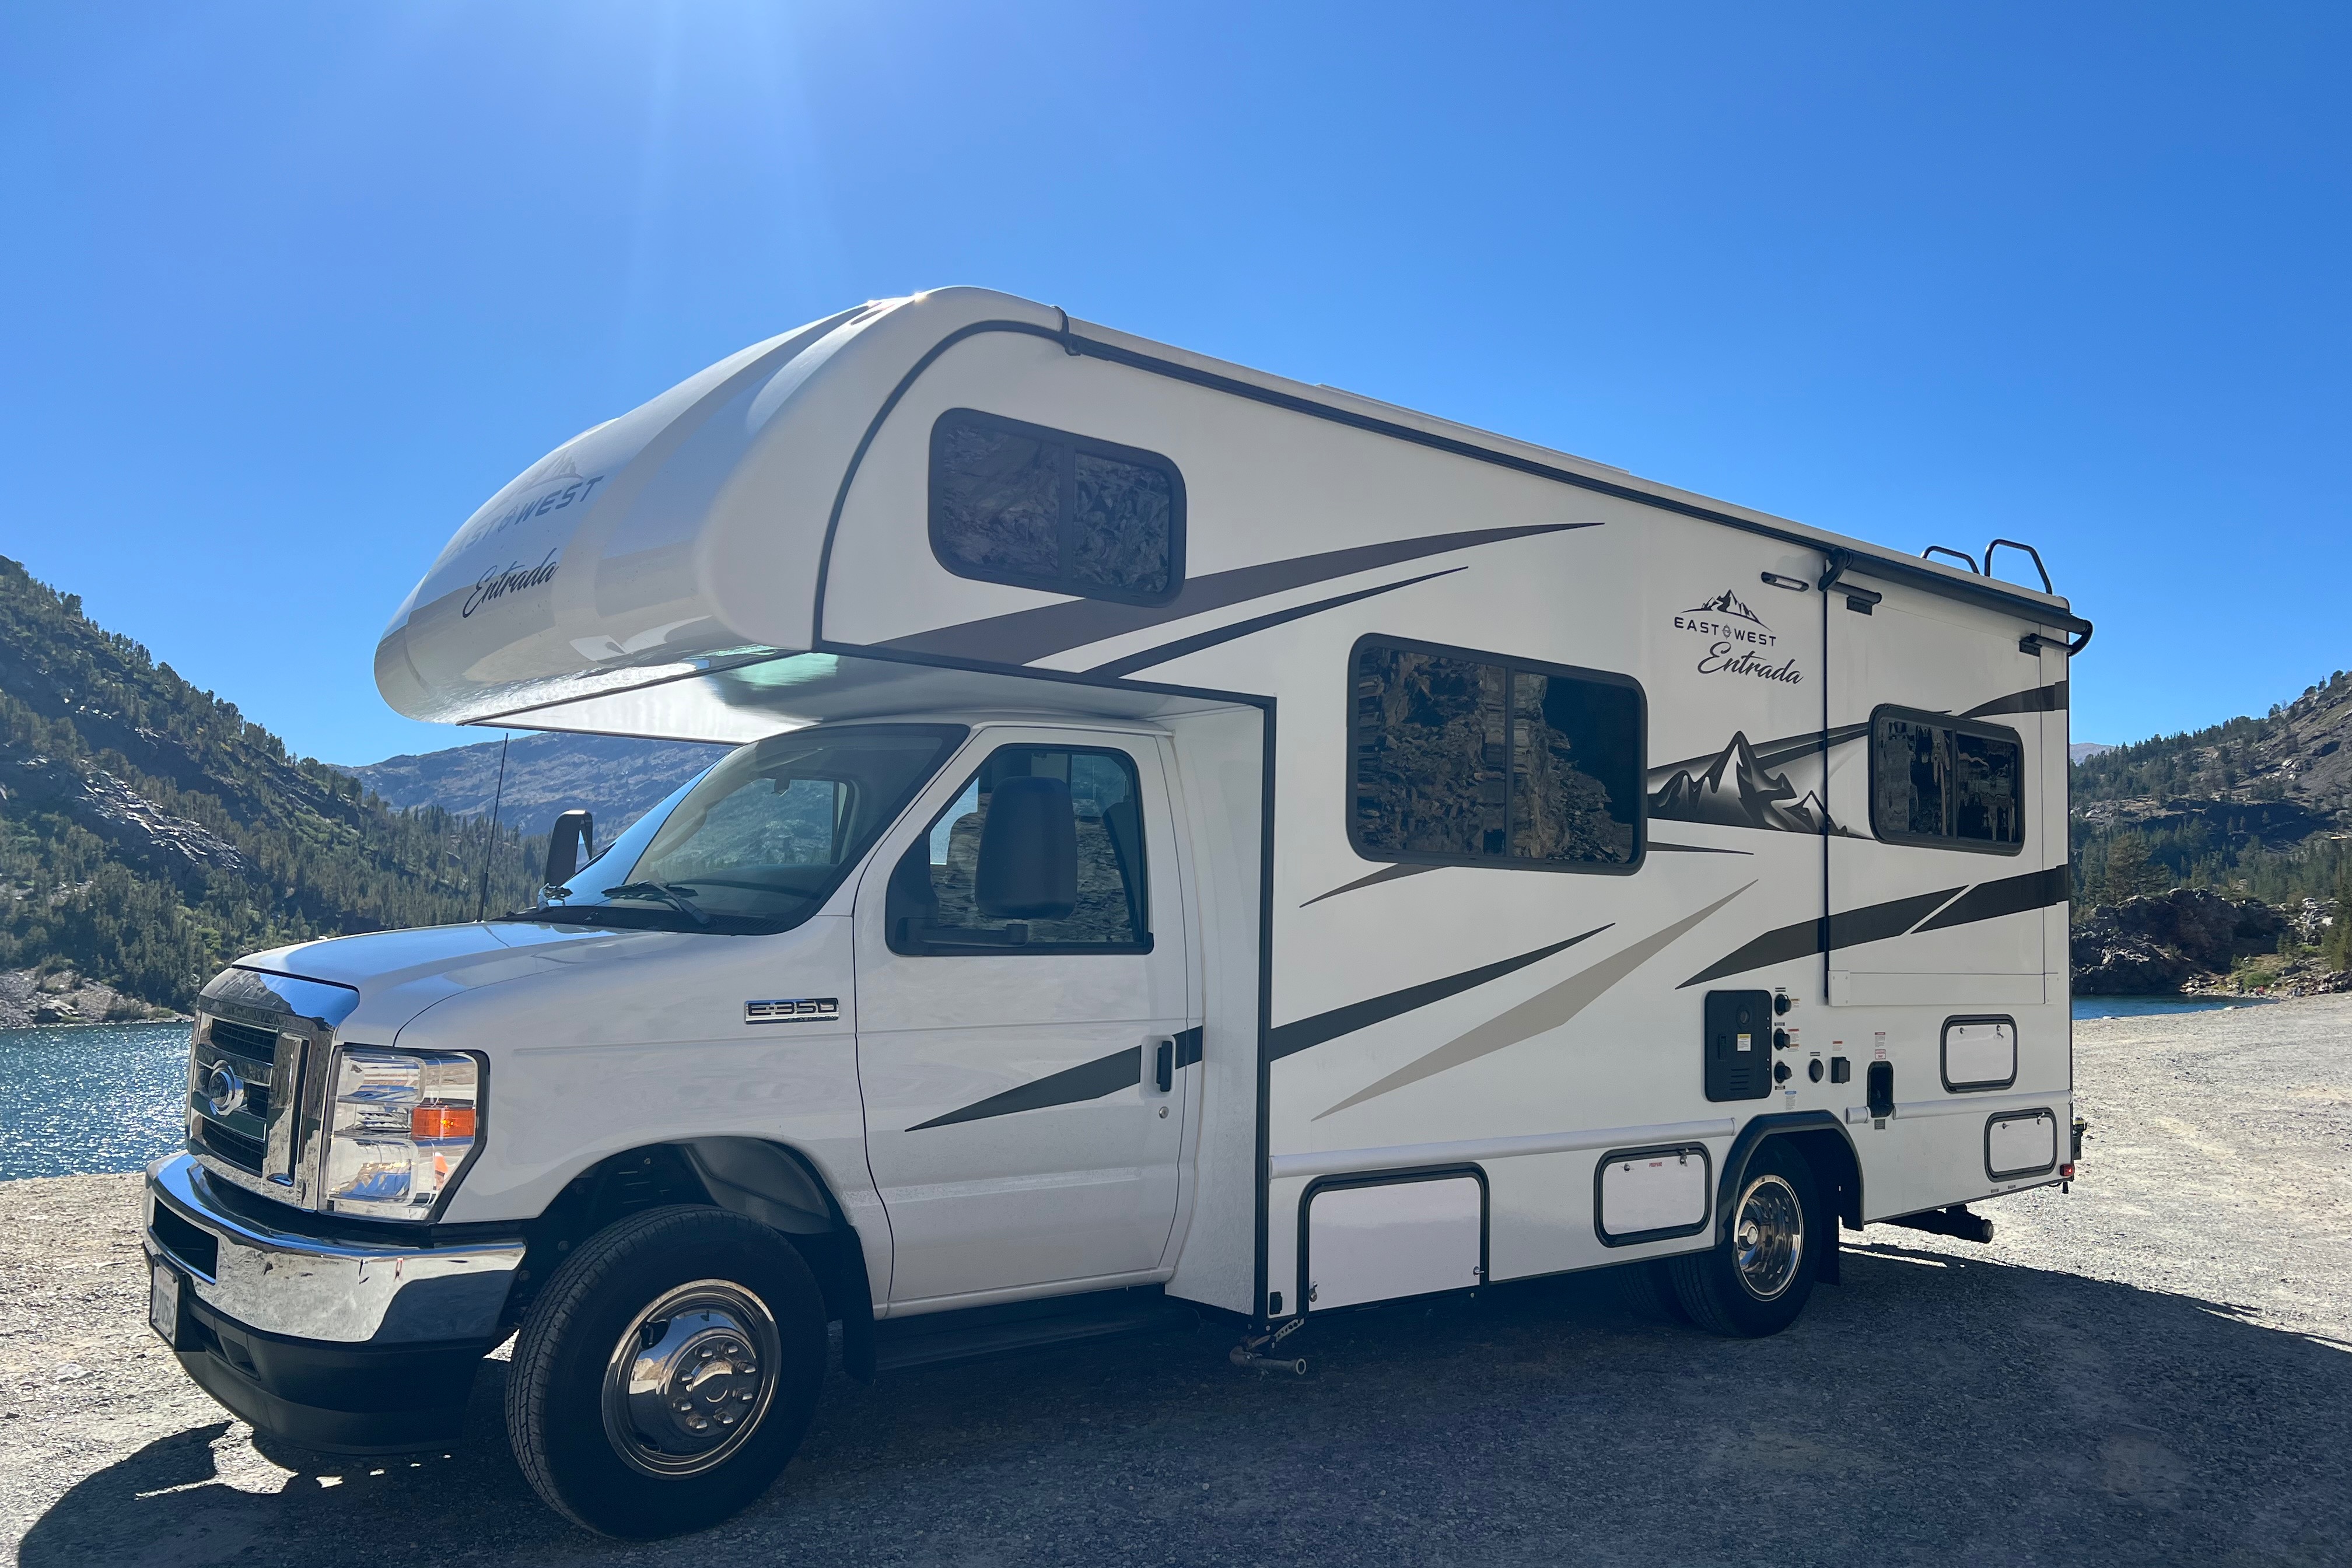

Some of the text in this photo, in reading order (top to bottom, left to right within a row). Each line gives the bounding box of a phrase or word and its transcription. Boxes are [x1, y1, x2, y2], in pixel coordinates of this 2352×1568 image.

[514, 475, 604, 525] WEST
[462, 547, 559, 618] Entrada
[1674, 617, 1776, 646] EAST WEST
[1698, 641, 1804, 684] Entrada
